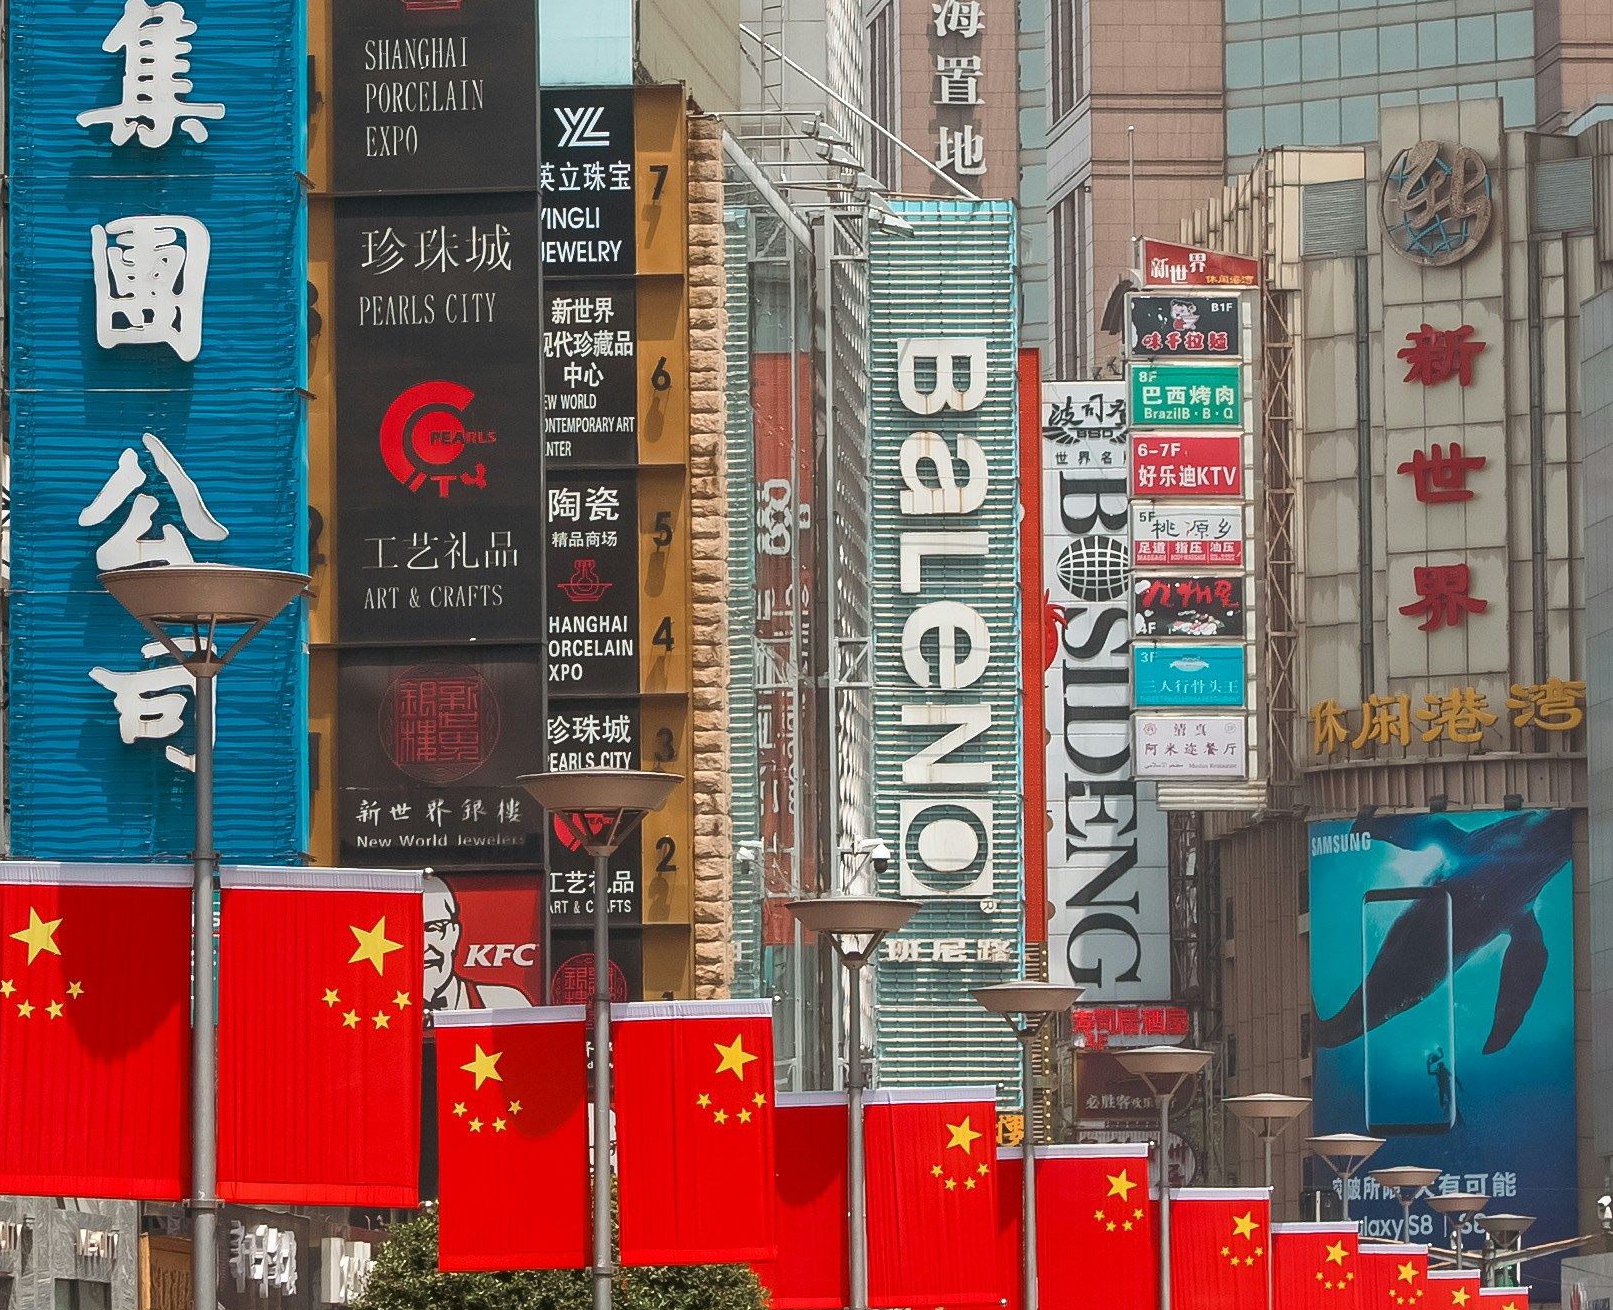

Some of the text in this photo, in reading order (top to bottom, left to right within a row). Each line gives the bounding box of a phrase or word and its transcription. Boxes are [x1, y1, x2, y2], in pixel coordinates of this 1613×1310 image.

[364, 37, 469, 71] SHANGHAI
[365, 79, 485, 114] PORCELAIN
[365, 125, 419, 158] EXPO
[540, 159, 632, 192] 英立珠宝
[649, 164, 669, 200] 7
[360, 223, 513, 276] 珍珠城
[1150, 252, 1207, 284] 新世界
[359, 291, 497, 327] PEARLS CITY
[551, 297, 615, 325] 新世界
[1211, 302, 1234, 313] B1F
[563, 361, 605, 389] 中心
[650, 356, 672, 391] 6
[1138, 371, 1158, 383] 8F
[560, 393, 597, 410] WORLD
[1141, 386, 1235, 407] 巴西烤肉
[615, 416, 635, 432] ART
[1055, 450, 1126, 466] 世界名
[1137, 442, 1181, 458] 6-7F
[1138, 464, 1237, 488] 好乐迪KTV
[1396, 323, 1487, 633] 新世界
[547, 486, 621, 523] 陶瓷
[1139, 511, 1156, 523] 5F
[551, 530, 619, 549] 精品商场
[652, 511, 673, 547] 5
[361, 530, 519, 571] 工艺礼品
[363, 584, 504, 610] ART & CRAFTS
[548, 615, 629, 634] HANGHAI
[651, 616, 675, 652] 4
[548, 638, 634, 657] ORCELAIN
[548, 663, 584, 682] XPO
[1311, 676, 1587, 755] 休闲港湾
[654, 726, 675, 762] 3
[356, 834, 392, 848] New
[399, 833, 448, 848] World
[1310, 830, 1372, 857] SAMSUNG
[655, 836, 677, 874] 2
[462, 942, 540, 968] KFC
[885, 938, 1014, 963] 班尼路
[1408, 1213, 1434, 1236] S8
